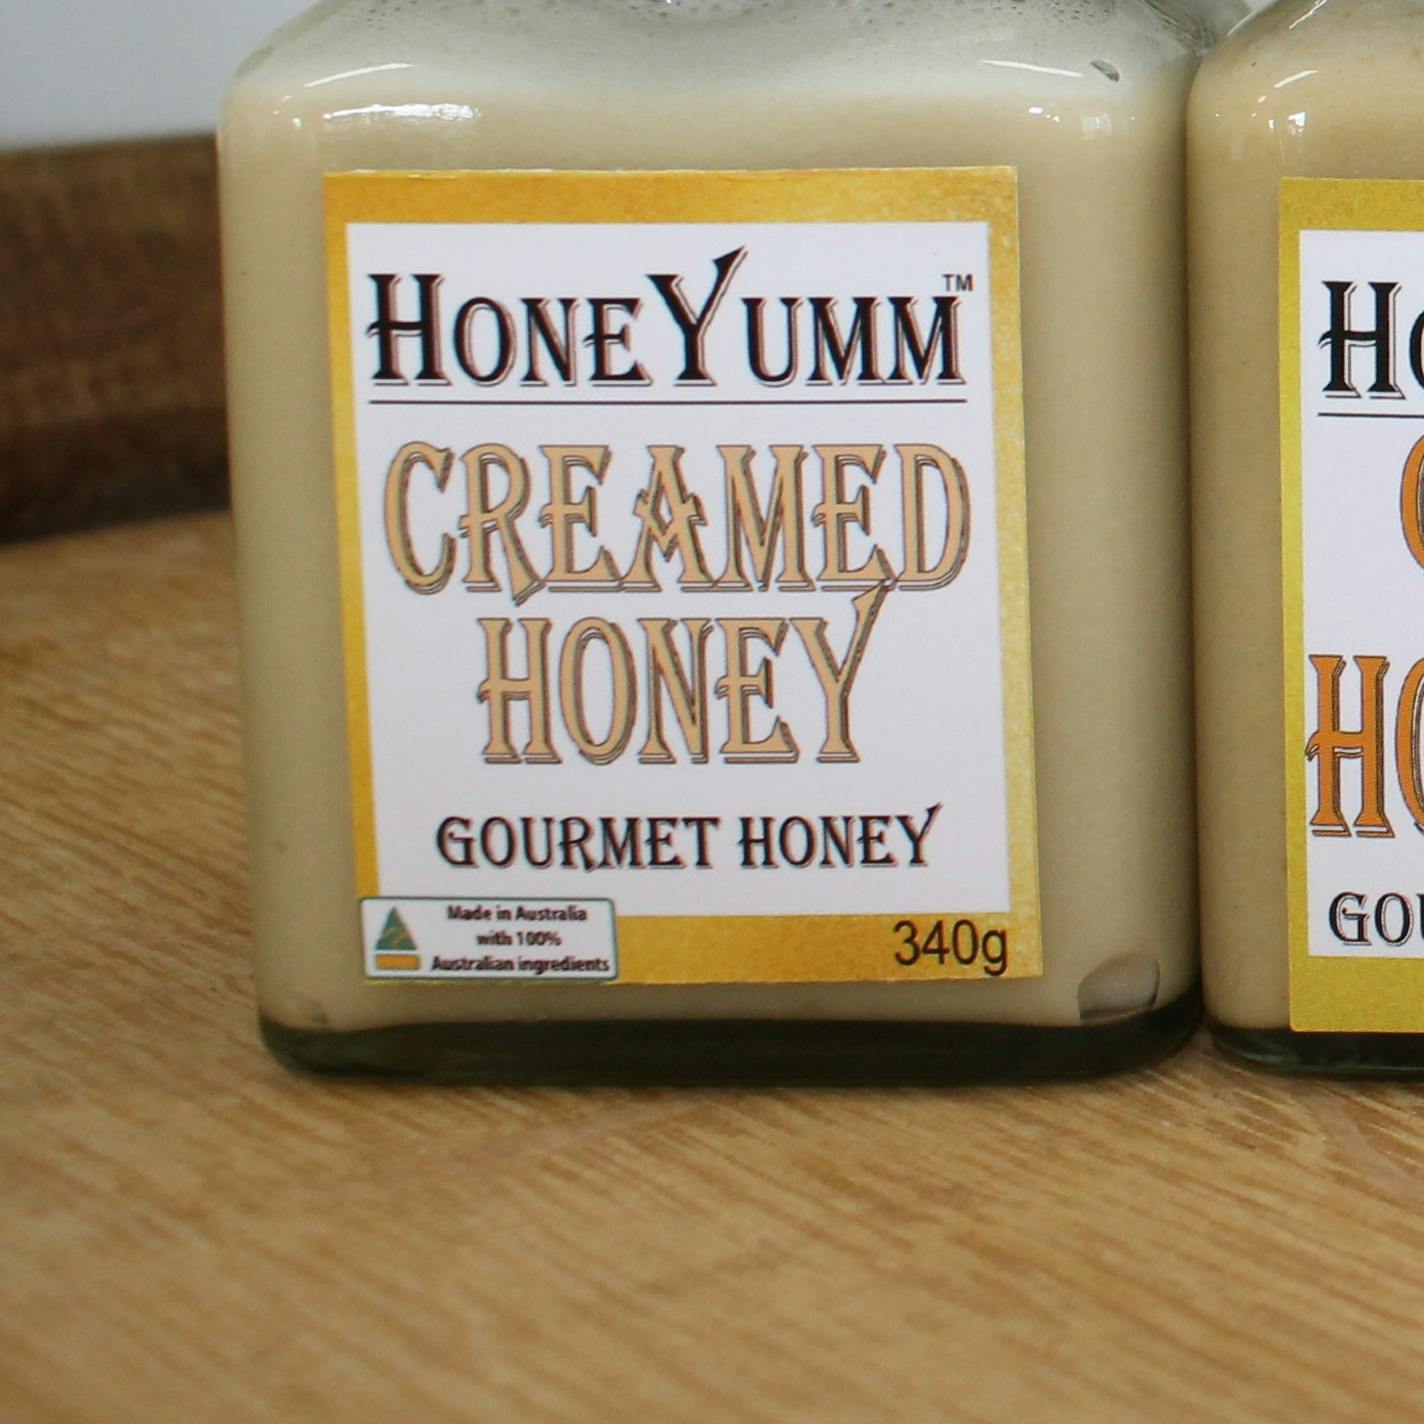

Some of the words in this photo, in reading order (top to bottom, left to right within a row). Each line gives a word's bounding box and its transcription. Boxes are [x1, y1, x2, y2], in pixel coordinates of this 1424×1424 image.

[383, 440, 971, 606] CREAMED
[477, 578, 896, 764] HONEY
[436, 815, 720, 872] GOURMET
[738, 803, 943, 870] HONEY
[448, 905, 492, 921] Made
[497, 905, 511, 921] in
[516, 905, 587, 922] Australia
[477, 931, 512, 946] with
[518, 931, 561, 946] 100%
[431, 955, 514, 971] Australian
[518, 956, 609, 975] ingredients
[893, 920, 1008, 974] 340g
